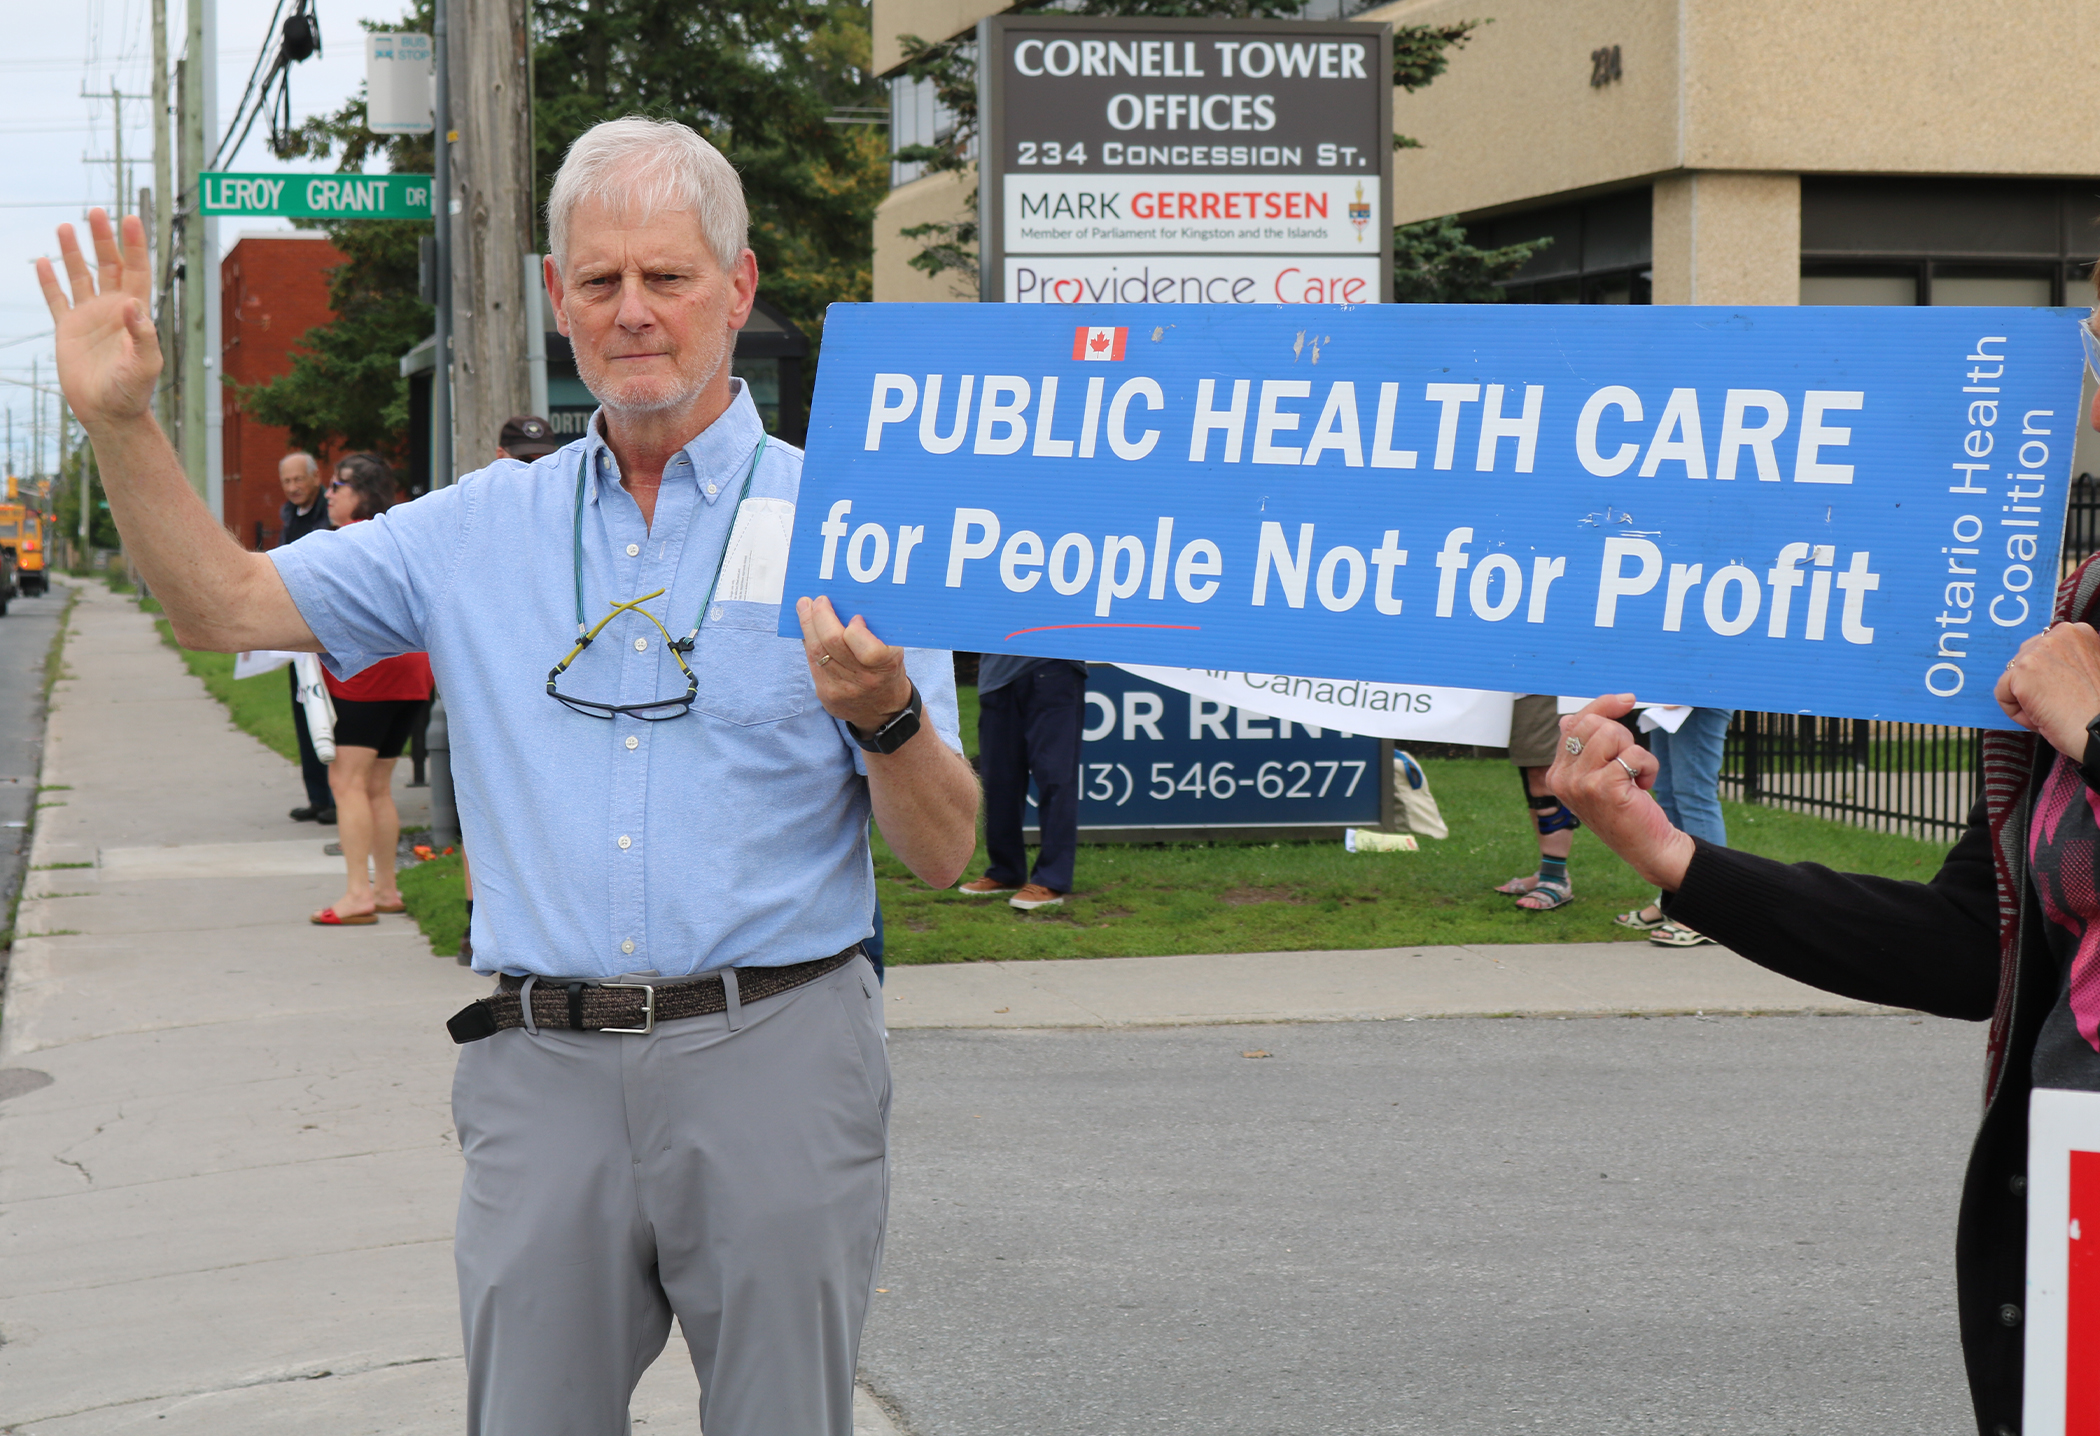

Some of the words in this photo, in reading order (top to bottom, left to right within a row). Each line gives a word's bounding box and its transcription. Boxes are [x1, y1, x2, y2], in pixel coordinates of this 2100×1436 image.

[398, 49, 430, 60] STOP
[400, 36, 428, 48] BUS
[1014, 39, 1205, 77] CORNELL
[1215, 42, 1367, 78] TOWER
[1107, 94, 1277, 131] OFFICES
[1017, 142, 1088, 165] 234
[205, 178, 285, 210] LEROY
[306, 179, 389, 211] GRANT
[405, 187, 428, 206] DR
[1021, 192, 1121, 219] MARK
[1131, 192, 1328, 219] GERRETSEN
[1021, 227, 1073, 240] Member
[1075, 227, 1089, 240] of
[1092, 227, 1157, 240] Parliament
[1160, 227, 1178, 240] for
[1181, 227, 1236, 242] Kingston
[1238, 227, 1261, 239] and
[1264, 227, 1284, 239] the
[1287, 227, 1329, 239] Islands
[1275, 267, 1367, 303] Care
[864, 373, 1165, 461] PUBLIC
[1188, 379, 1545, 474] HEALTH
[1576, 385, 1865, 485] CARE
[1949, 336, 2007, 494] Health
[1989, 410, 2054, 627] Coalition
[819, 499, 925, 585] for
[945, 507, 1223, 618] People
[1251, 520, 1409, 616] Not
[1435, 526, 1567, 624] for
[1594, 536, 1881, 645] Profit
[1925, 514, 1983, 697] Ontario
[1082, 691, 1164, 741] OR
[1189, 693, 1354, 740] RE
[1149, 760, 1367, 800] 546-6277
